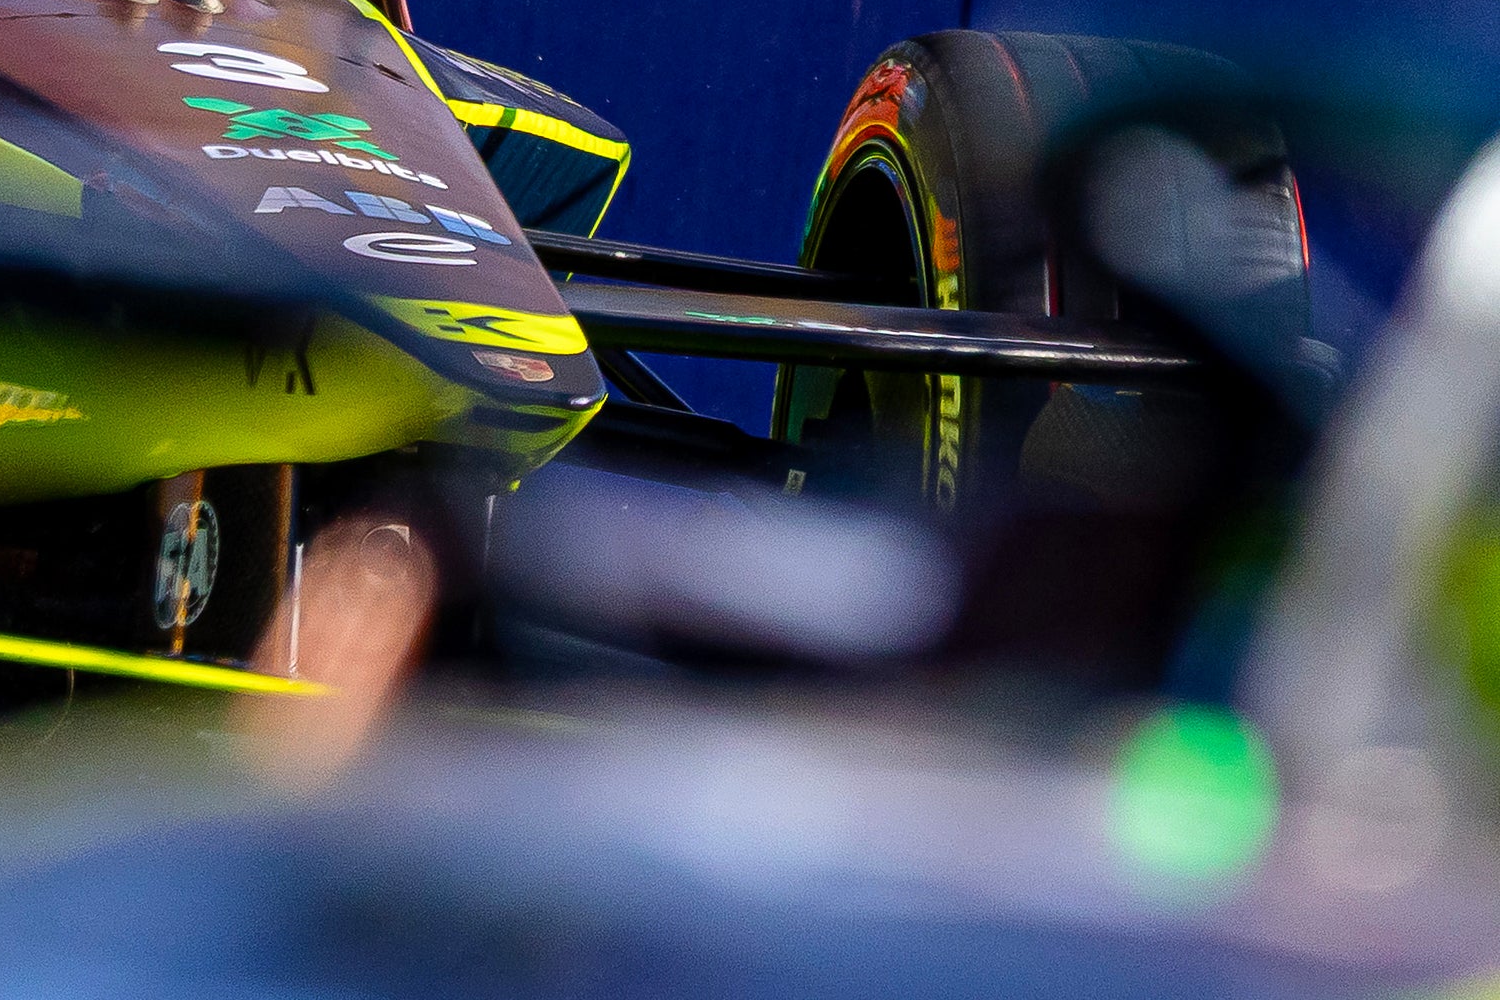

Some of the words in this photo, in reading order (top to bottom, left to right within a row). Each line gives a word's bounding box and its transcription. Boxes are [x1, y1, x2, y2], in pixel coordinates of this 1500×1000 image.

[157, 42, 330, 93] 3
[201, 145, 450, 190] Duelbits
[254, 187, 512, 246] ABB
